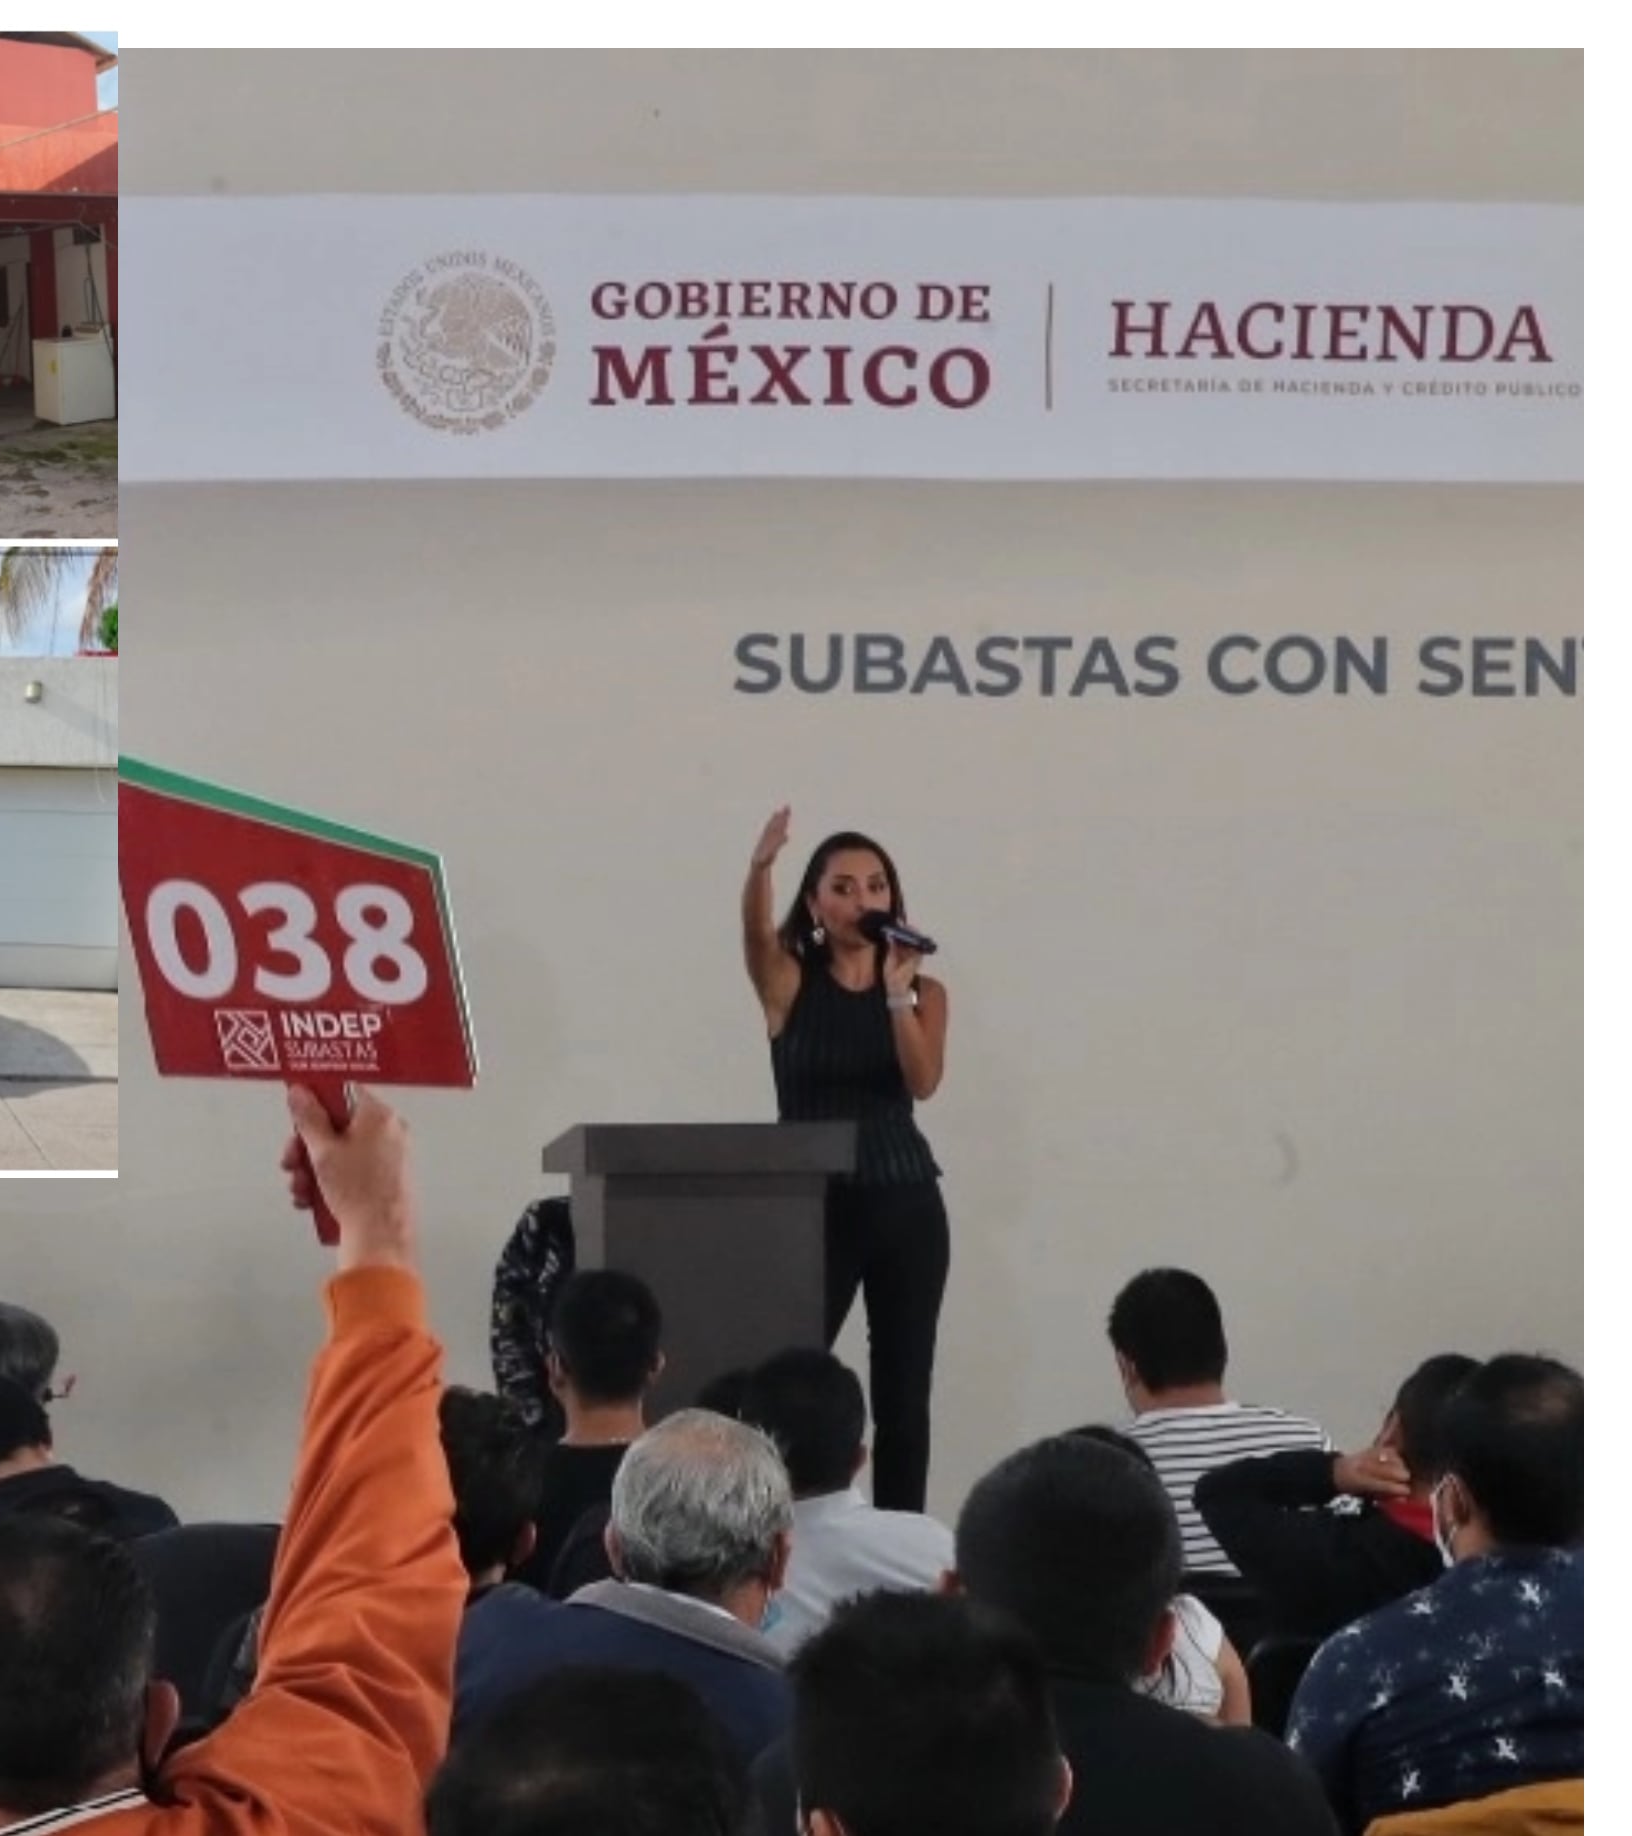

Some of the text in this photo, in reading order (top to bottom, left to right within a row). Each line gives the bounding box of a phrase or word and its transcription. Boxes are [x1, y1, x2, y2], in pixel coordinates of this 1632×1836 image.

[591, 281, 991, 322] GOBIERNO DE
[1108, 300, 1554, 362] HACIENDA
[589, 322, 991, 408] MÉXICO
[1238, 378, 1265, 393] DE
[1273, 379, 1376, 396] HACIENDA
[1383, 381, 1394, 396] Y
[1402, 378, 1488, 397] CRÉDITO
[733, 632, 1584, 697] SUBASTAS CON SEN
[146, 878, 428, 1005] 038
[280, 1010, 382, 1038] INDEP
